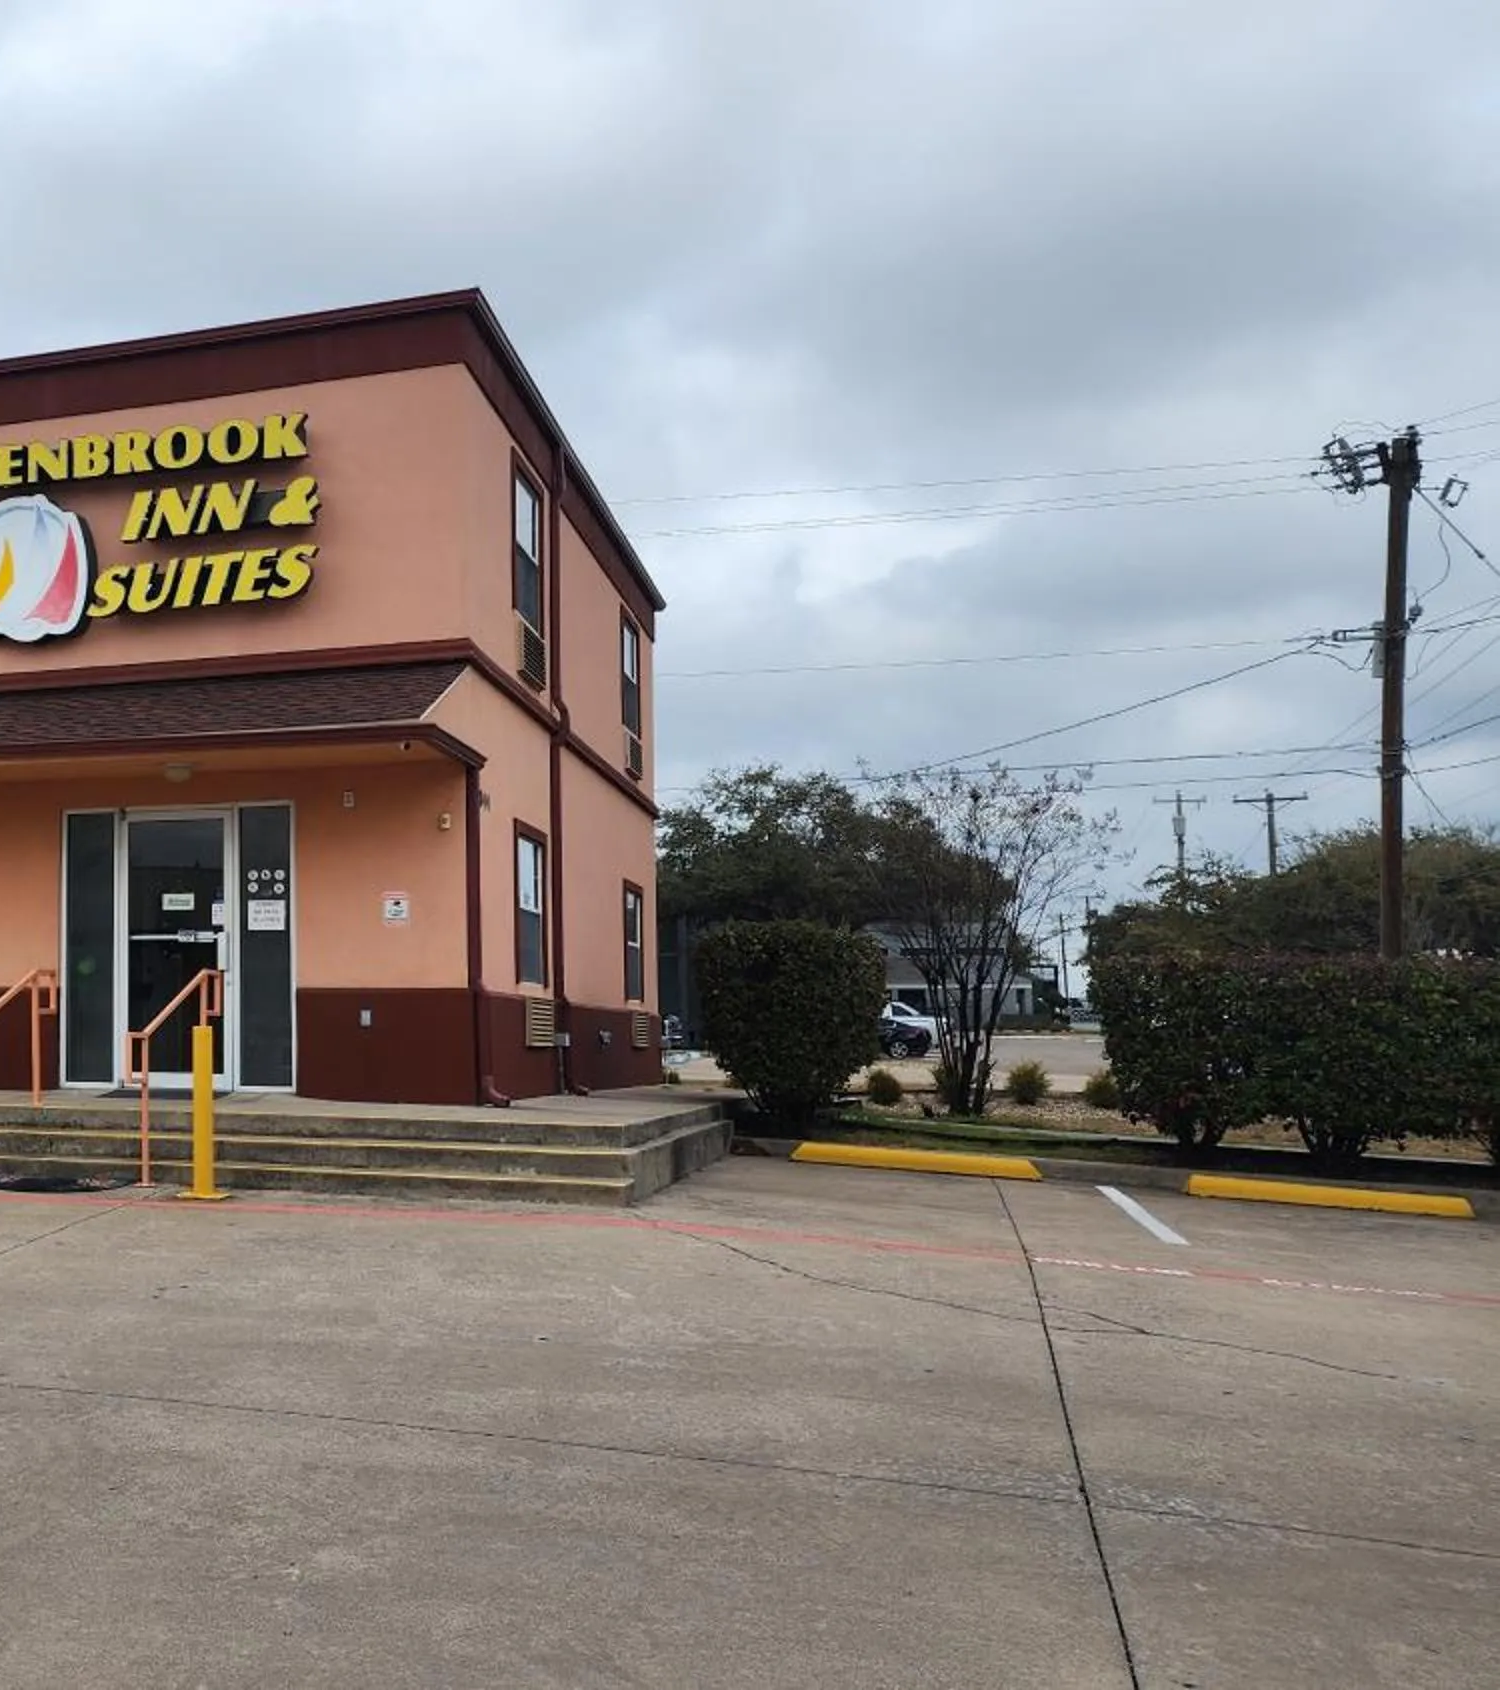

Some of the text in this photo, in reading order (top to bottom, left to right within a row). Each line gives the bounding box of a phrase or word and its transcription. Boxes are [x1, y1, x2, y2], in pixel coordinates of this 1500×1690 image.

[121, 476, 319, 541] INN &
[87, 543, 317, 618] SUITES
